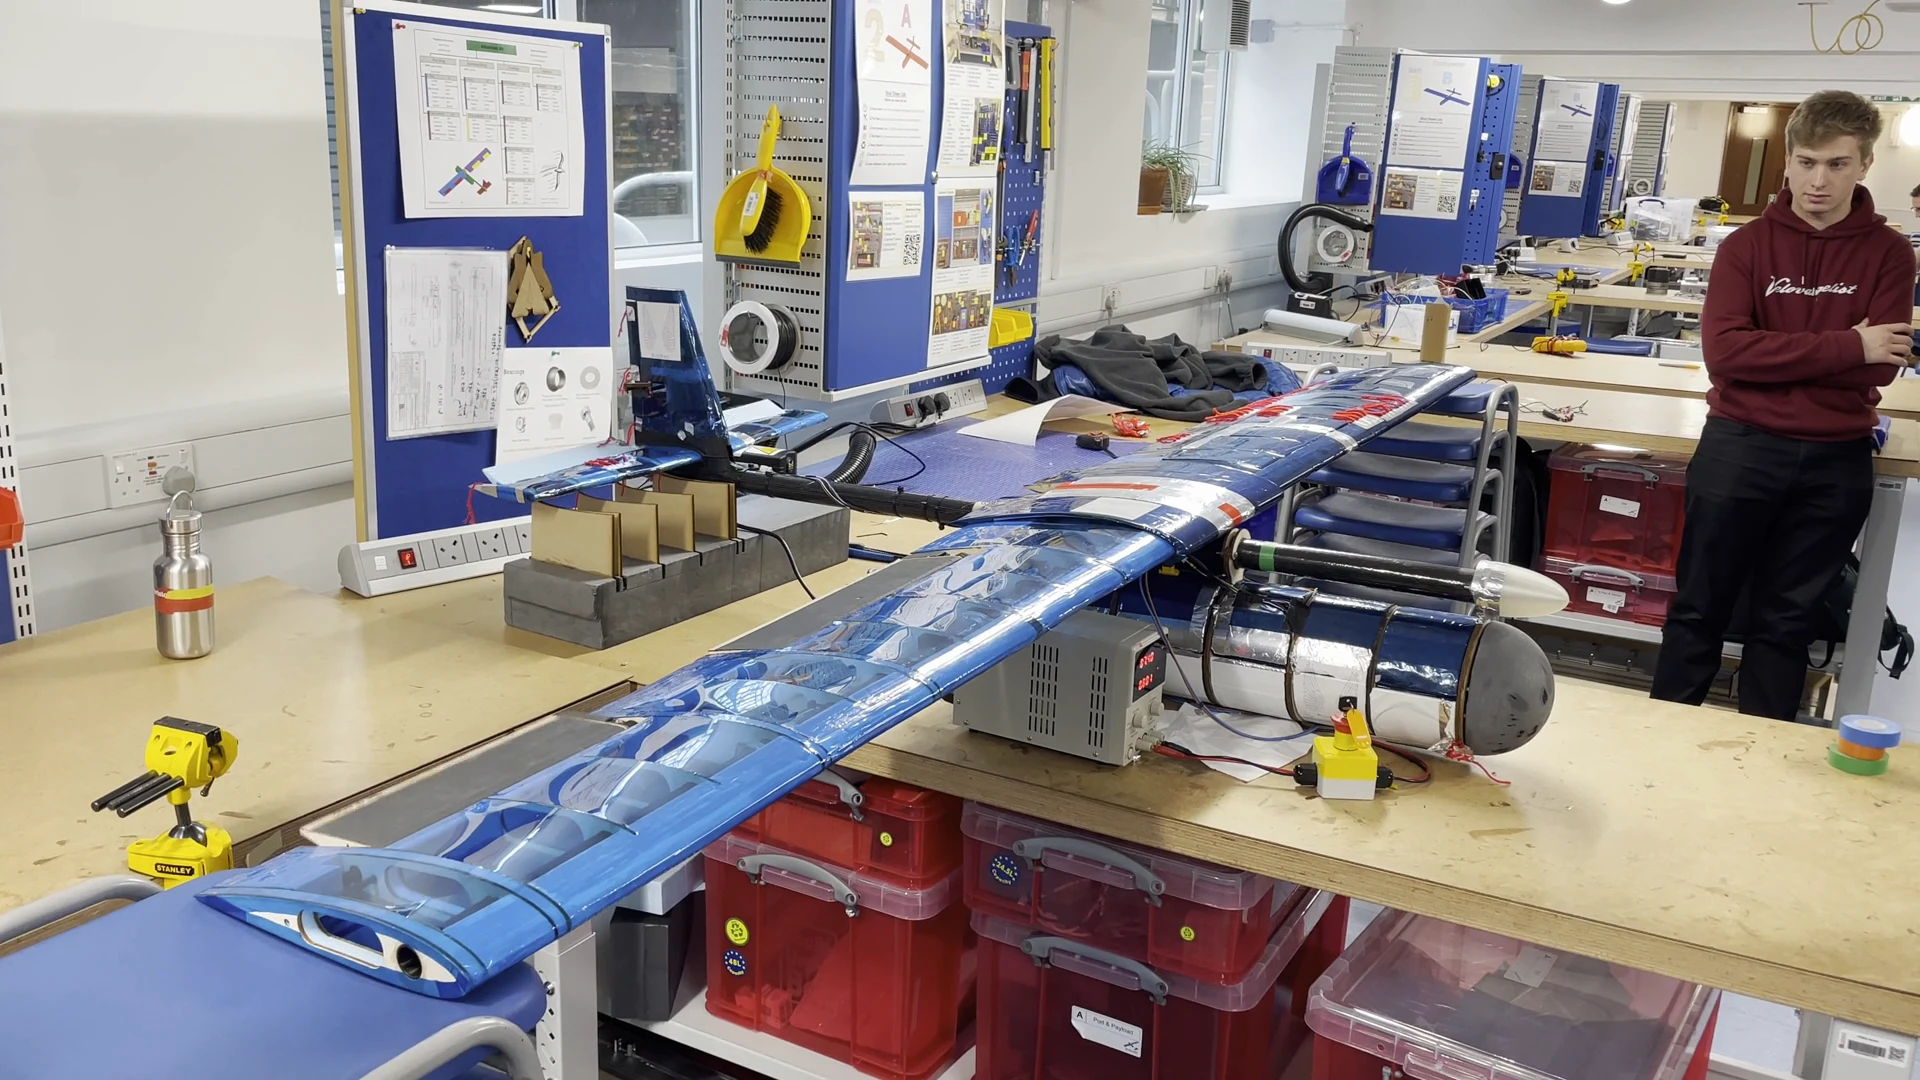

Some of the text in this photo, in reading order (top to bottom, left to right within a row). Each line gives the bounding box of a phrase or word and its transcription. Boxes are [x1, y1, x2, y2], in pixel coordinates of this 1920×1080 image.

[901, 4, 912, 28] A
[156, 864, 192, 874] STANLEY
[1076, 1011, 1084, 1020] A
[1111, 1023, 1134, 1035] Payload
